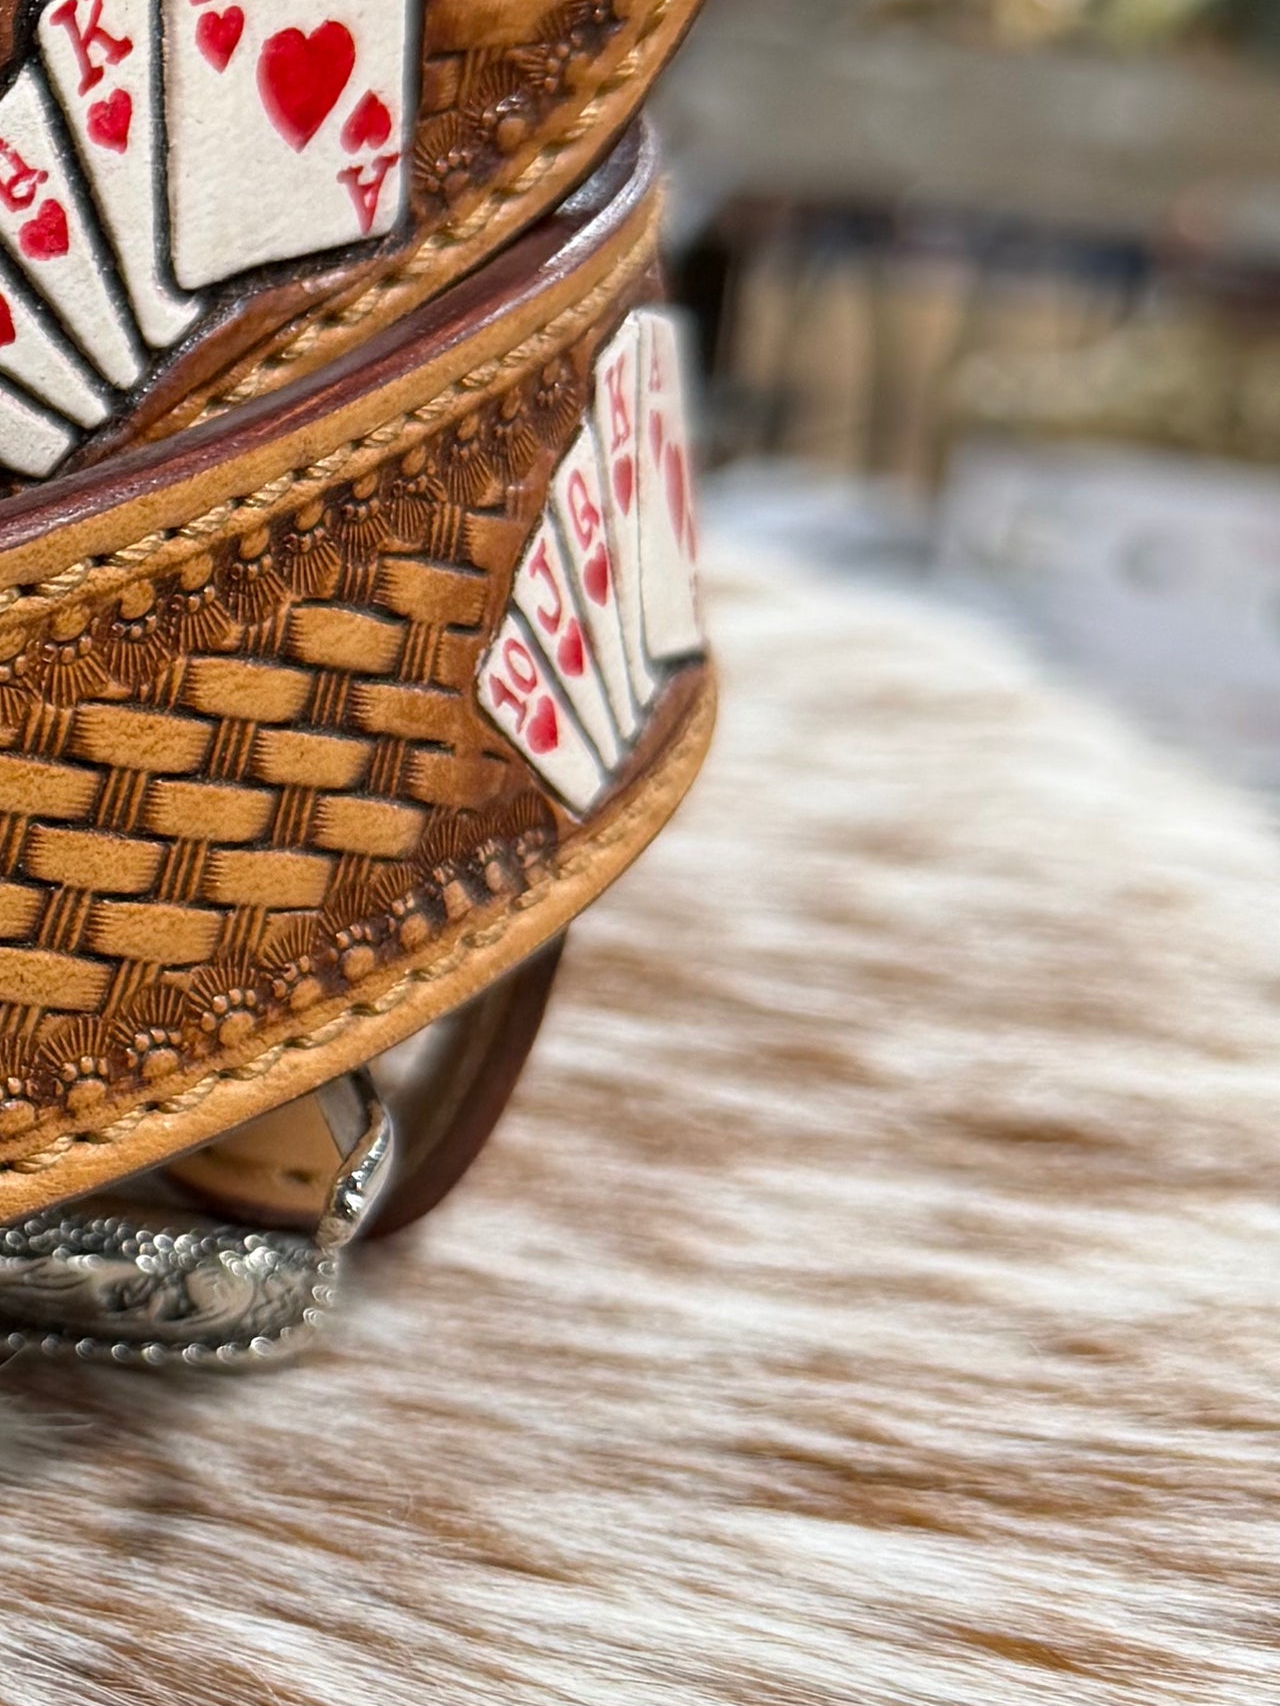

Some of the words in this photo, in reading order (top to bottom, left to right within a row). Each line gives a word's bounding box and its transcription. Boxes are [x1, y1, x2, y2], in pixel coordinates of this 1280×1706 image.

[337, 151, 402, 235] A
[604, 353, 631, 455] K
[567, 468, 602, 552] Q
[528, 537, 563, 636] J
[487, 636, 539, 735] 10
